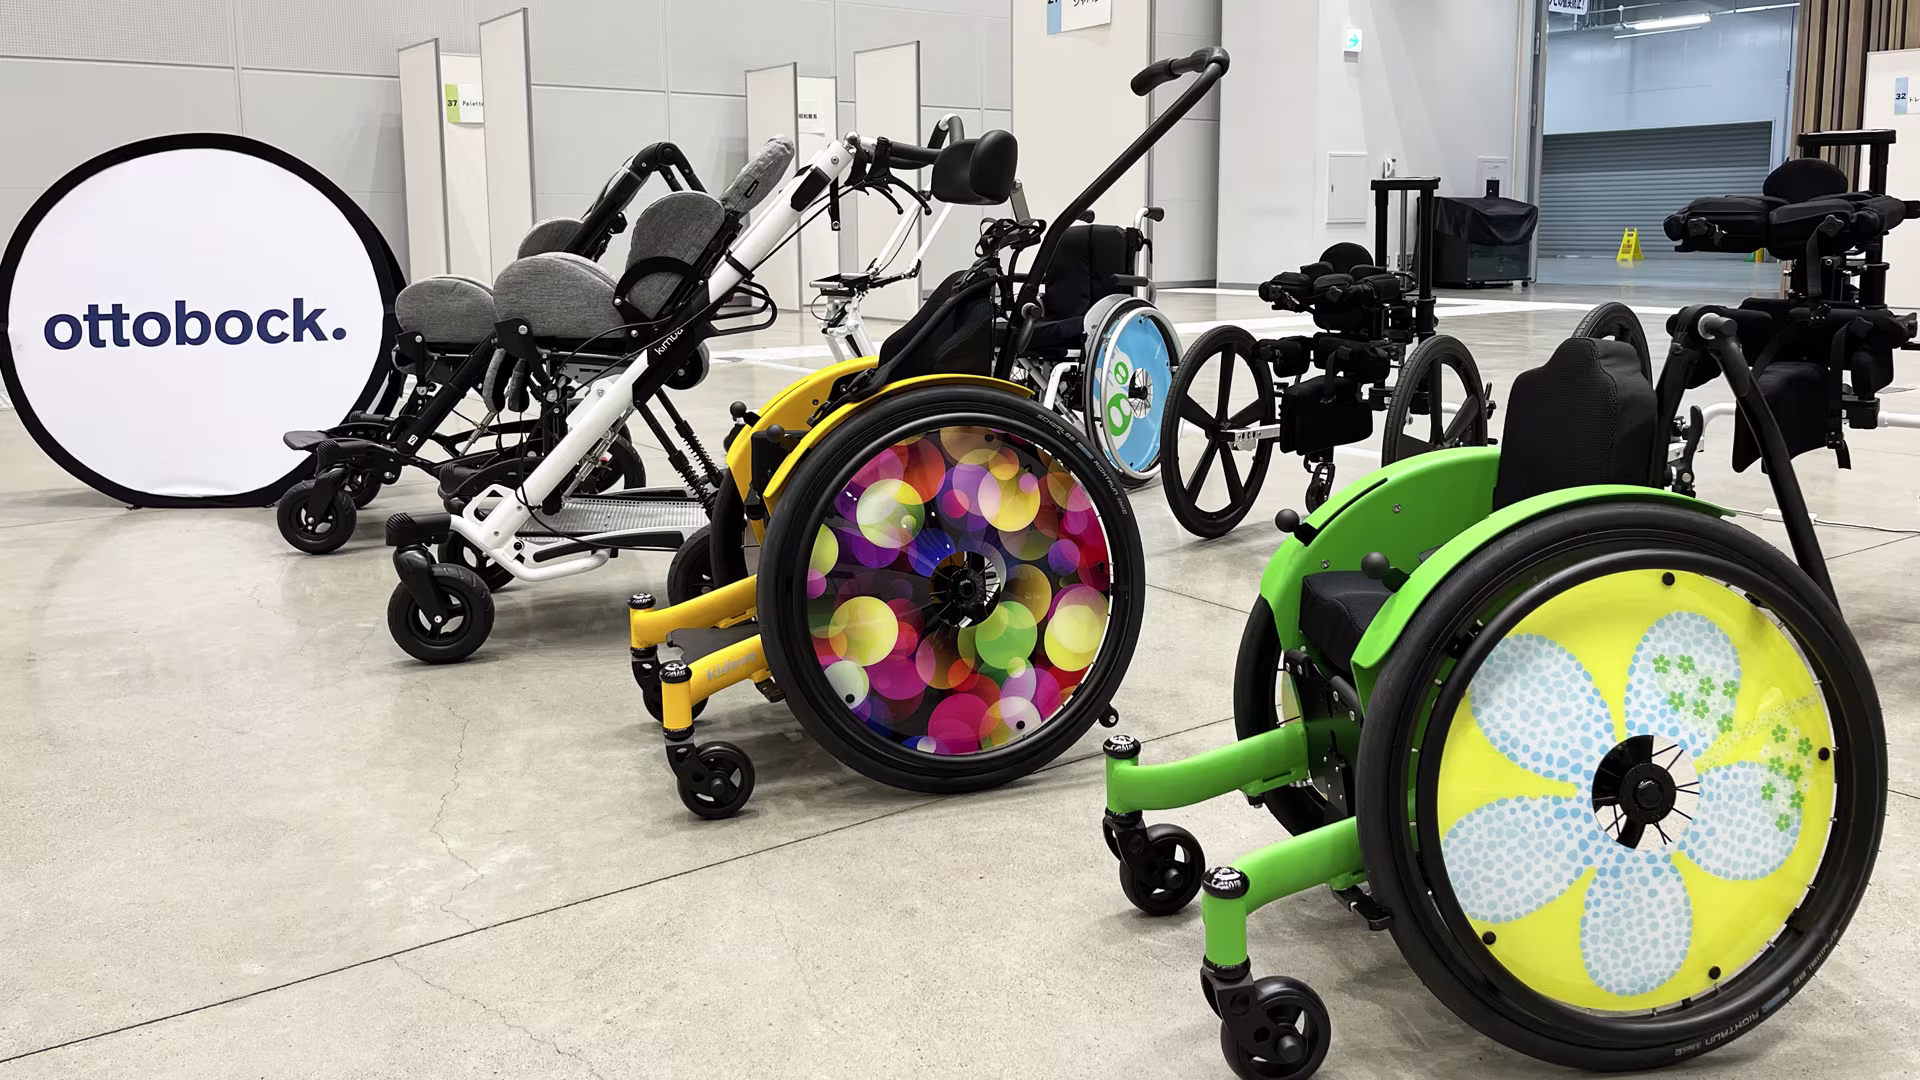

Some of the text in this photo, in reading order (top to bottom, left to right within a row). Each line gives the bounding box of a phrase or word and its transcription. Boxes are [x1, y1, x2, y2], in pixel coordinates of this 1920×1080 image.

[44, 298, 346, 350] ottobock.
[1037, 414, 1119, 496] SCHWALBE RIGHTRUN
